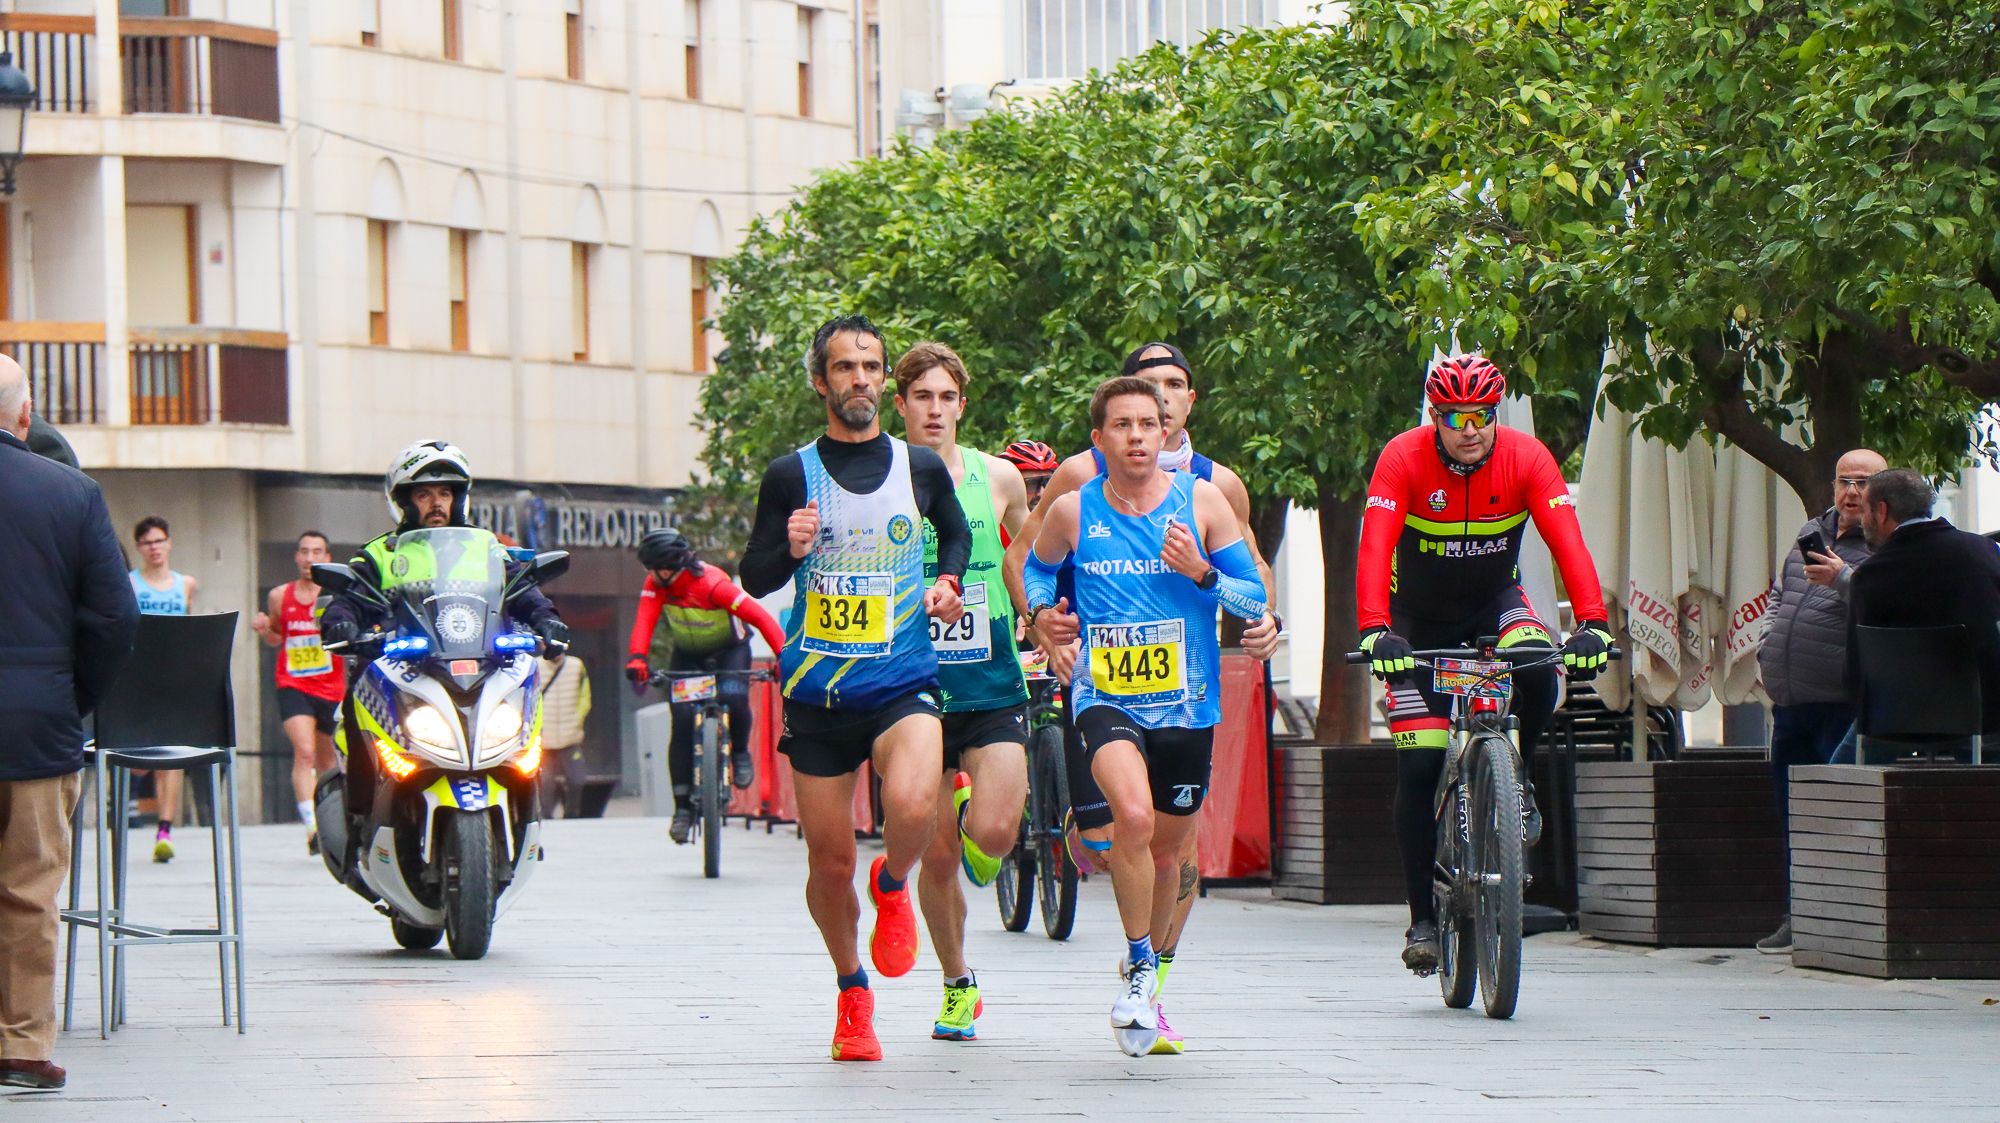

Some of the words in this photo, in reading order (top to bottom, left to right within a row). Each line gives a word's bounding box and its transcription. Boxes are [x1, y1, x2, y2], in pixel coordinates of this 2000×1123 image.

[1446, 537, 1508, 551] MILAR
[1446, 545, 1508, 558] LUCENA
[819, 597, 869, 631] 334
[1100, 627, 1130, 648] 21K
[1103, 647, 1170, 682] 1443
